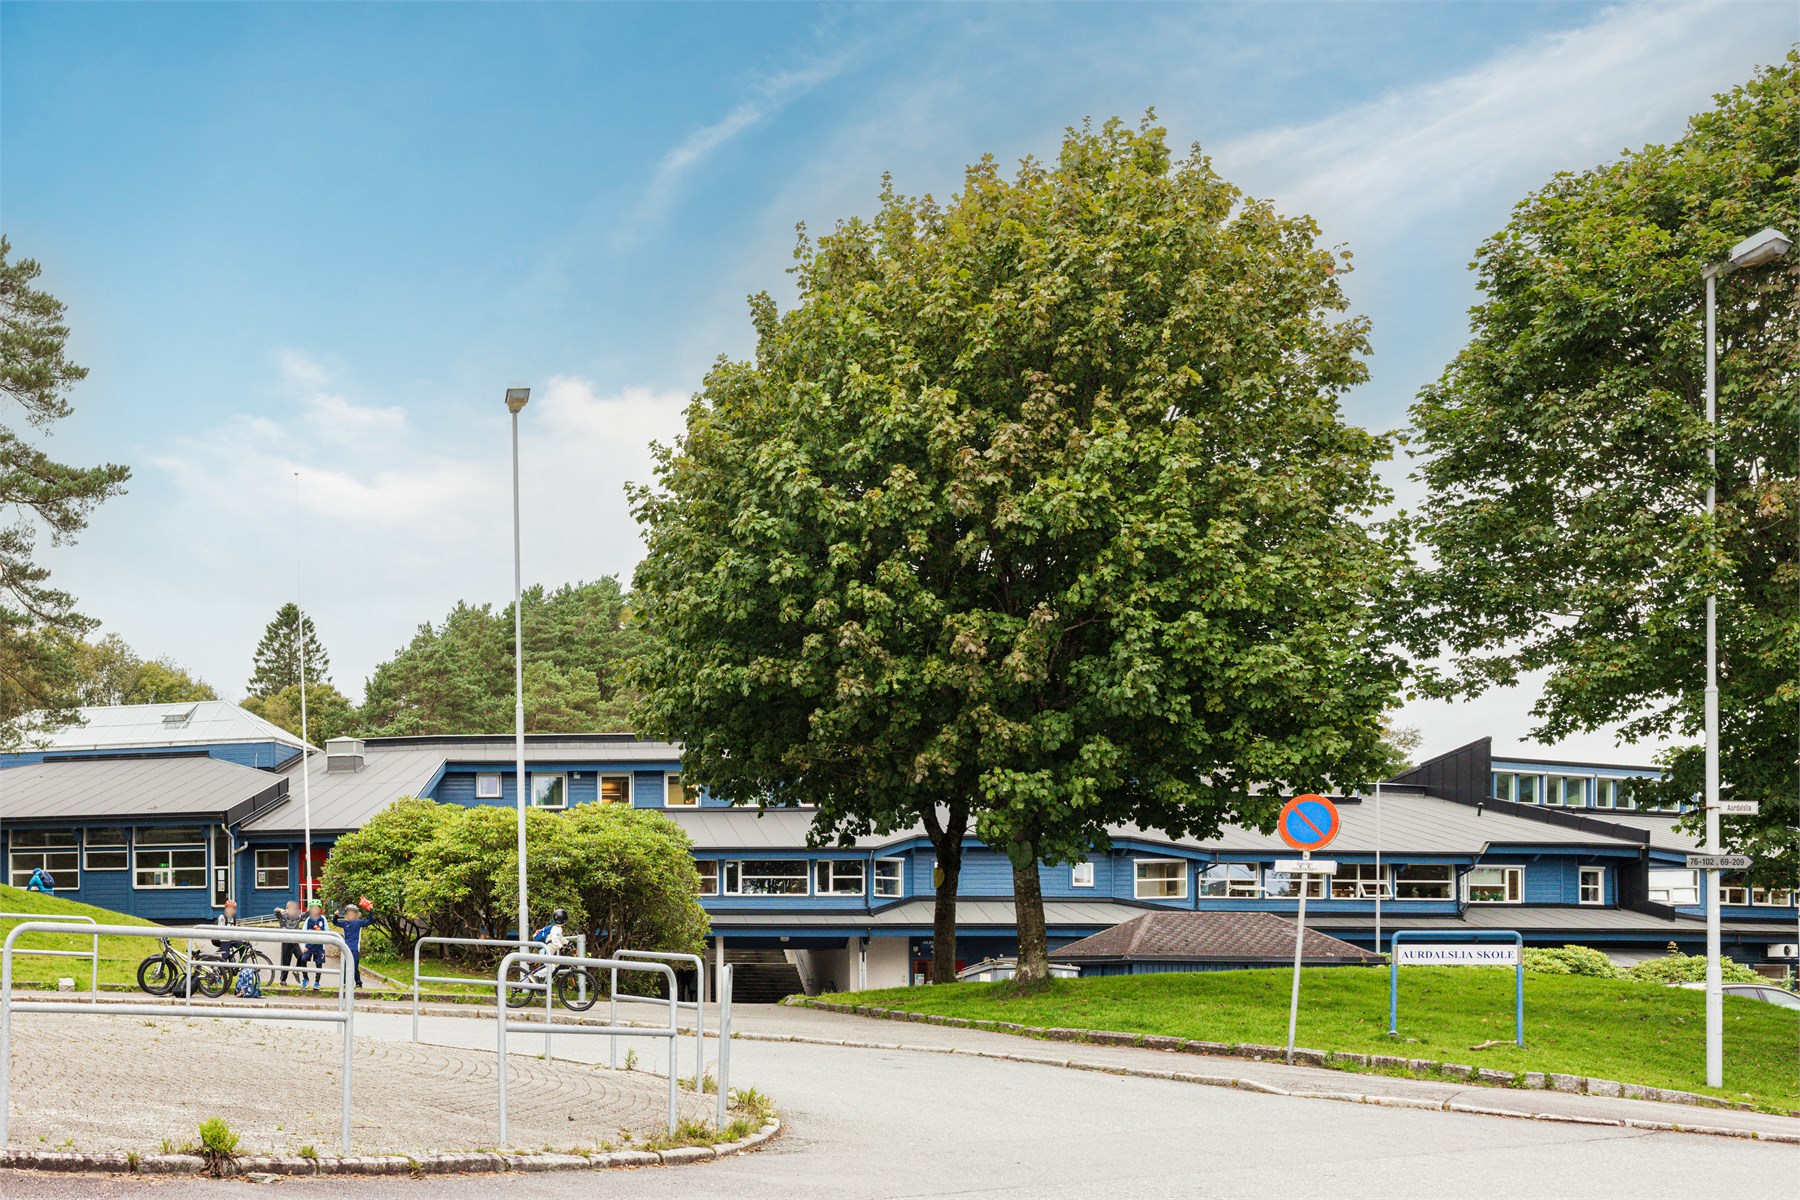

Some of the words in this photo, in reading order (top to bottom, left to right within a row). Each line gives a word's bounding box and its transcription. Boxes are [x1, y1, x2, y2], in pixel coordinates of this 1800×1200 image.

[1727, 804, 1752, 812] Aurdalslia
[1689, 857, 1715, 866] 76-102
[1720, 857, 1745, 866] 69-209
[1401, 950, 1473, 959] AURDALSLIA
[1476, 950, 1515, 959] SKOLE
